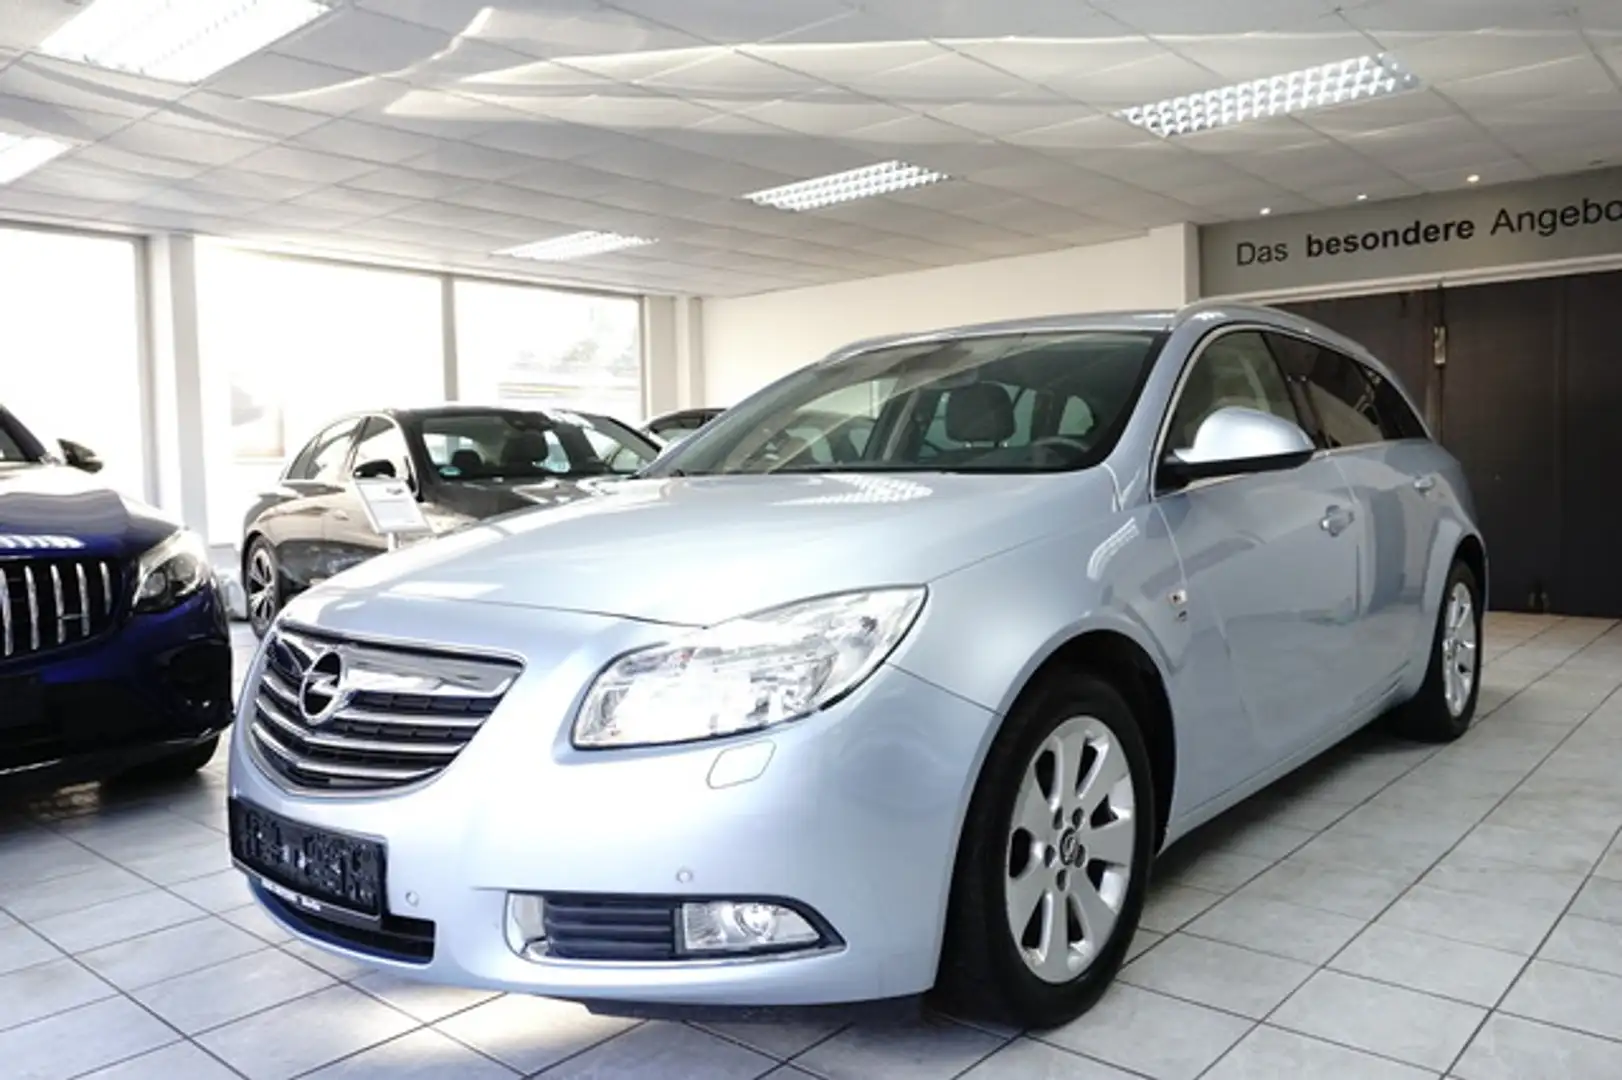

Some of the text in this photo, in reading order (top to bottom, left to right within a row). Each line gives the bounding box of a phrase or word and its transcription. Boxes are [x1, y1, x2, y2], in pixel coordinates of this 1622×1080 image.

[1237, 198, 1622, 267] Das besondere Angebo
